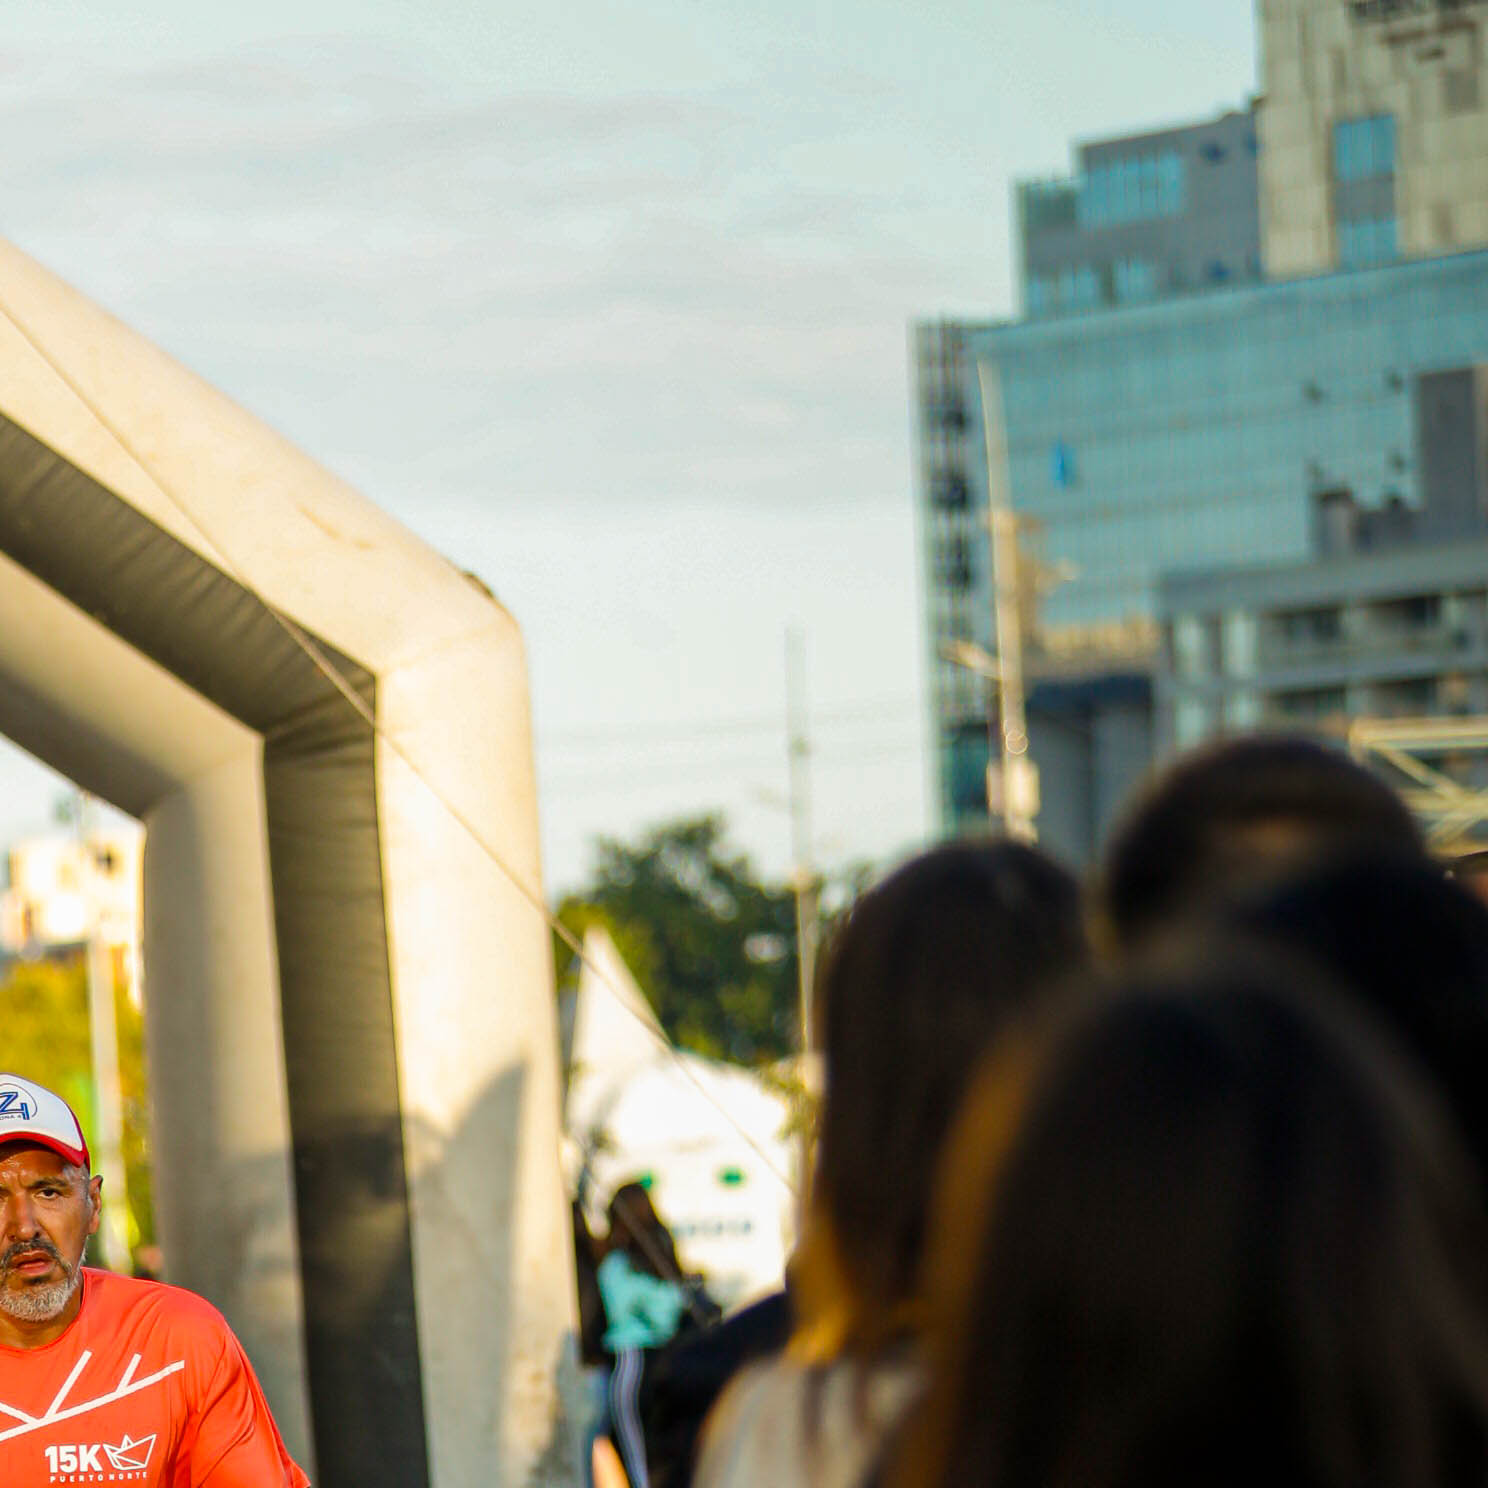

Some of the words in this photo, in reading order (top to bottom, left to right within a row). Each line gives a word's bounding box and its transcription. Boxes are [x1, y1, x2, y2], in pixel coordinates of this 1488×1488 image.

[45, 1444, 103, 1473] 15K
[50, 1473, 103, 1483] PUERTO
[109, 1470, 148, 1481] NORTE
